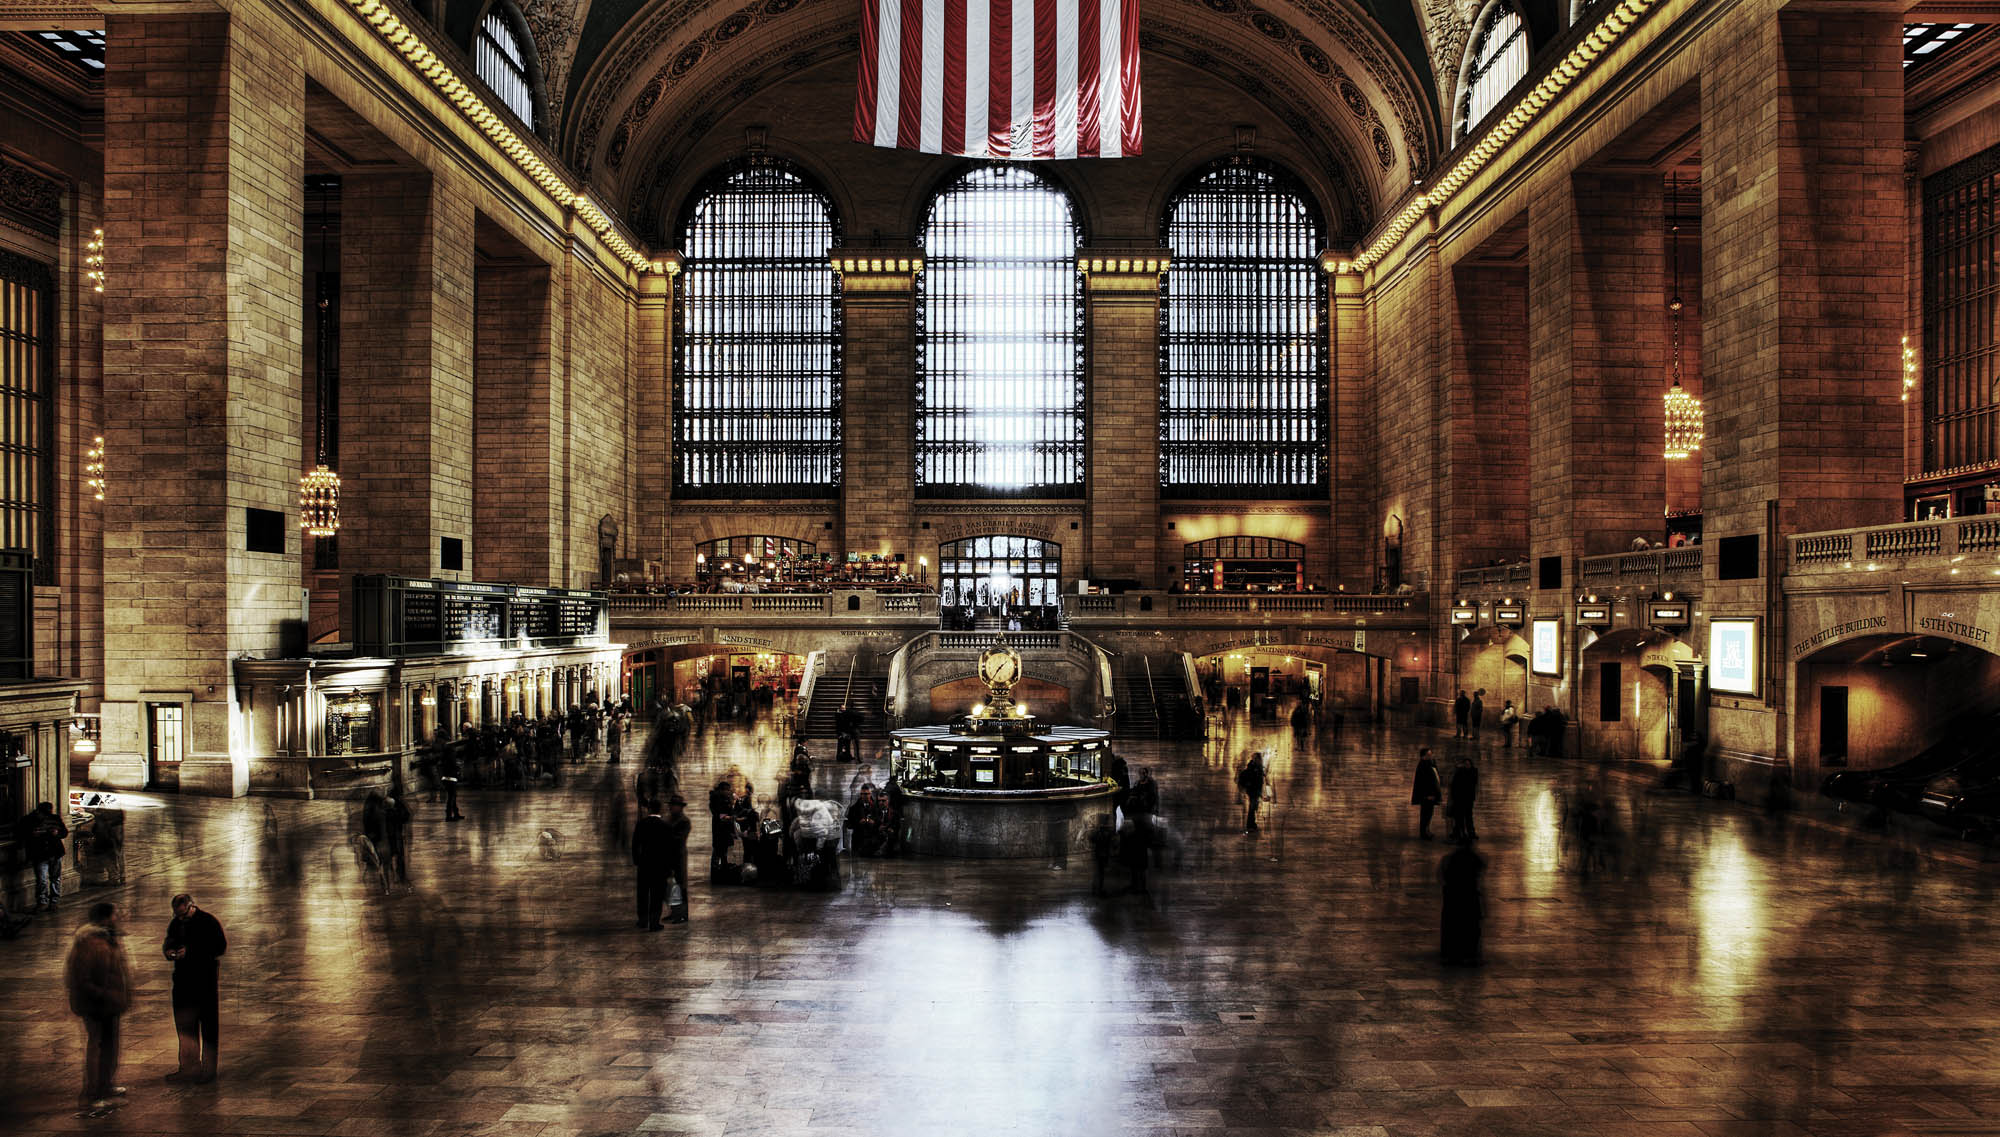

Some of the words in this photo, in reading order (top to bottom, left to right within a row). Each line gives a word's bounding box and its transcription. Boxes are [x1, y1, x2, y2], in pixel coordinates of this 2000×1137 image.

[1793, 640, 1809, 655] THE
[1810, 624, 1845, 647] METLIFE
[1845, 616, 1887, 634] BUILDING
[1919, 616, 1946, 631] 45TH
[1947, 621, 1990, 643] STREET
[629, 639, 660, 649] SUBWAY
[663, 635, 697, 644] SHUTTLE
[723, 635, 742, 643] 42ND
[743, 637, 773, 646] STREET
[1210, 640, 1236, 651] TICKET
[1239, 635, 1279, 646] MACHINES
[1304, 636, 1334, 645] TRACKS
